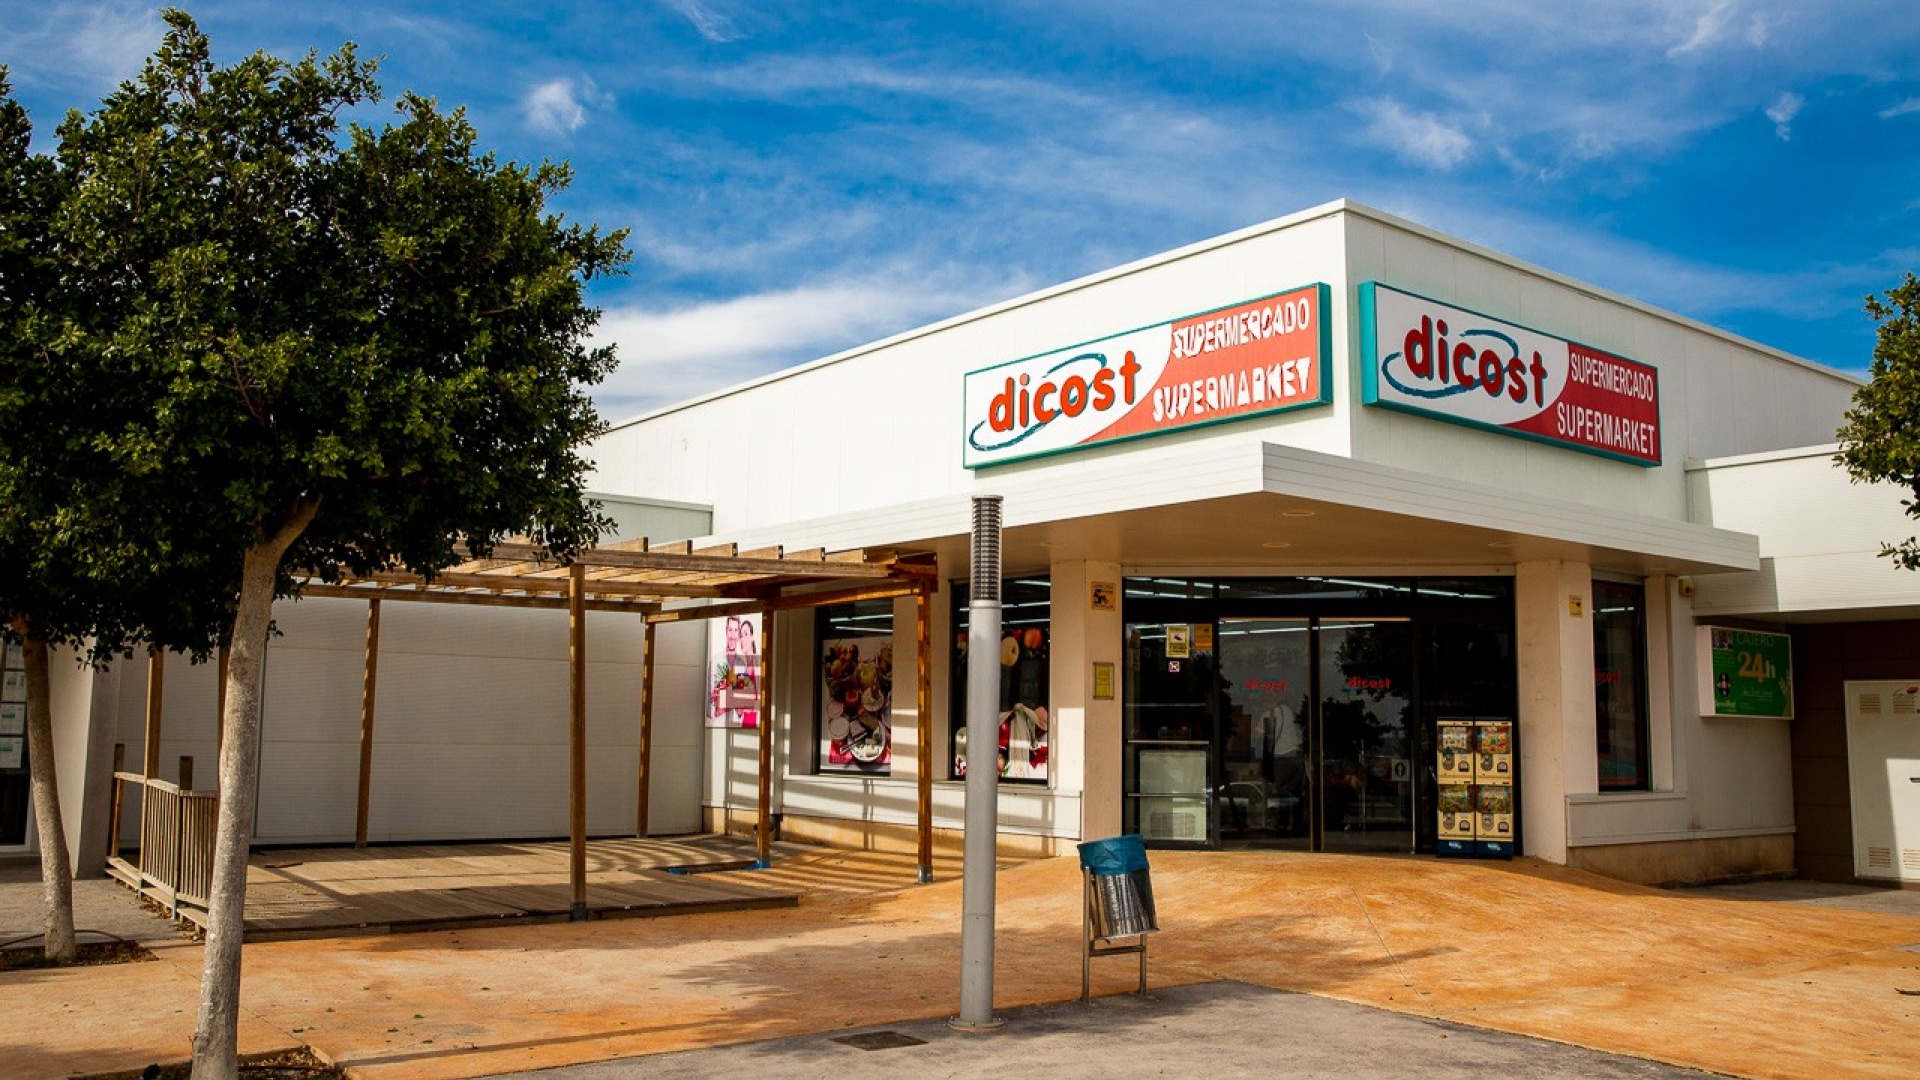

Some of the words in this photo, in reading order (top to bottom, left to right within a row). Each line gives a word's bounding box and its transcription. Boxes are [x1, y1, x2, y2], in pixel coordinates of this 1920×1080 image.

[1172, 297, 1310, 359] SUPERMERCADO
[1404, 314, 1548, 408] dicost
[1571, 353, 1653, 402] SUPERMERCADO
[989, 350, 1141, 433] dicost
[1152, 357, 1311, 423] SUPERMARKET
[1557, 402, 1655, 455] SUPERMARKET
[1736, 632, 1774, 647] CAJERO
[1346, 674, 1392, 689] dicost
